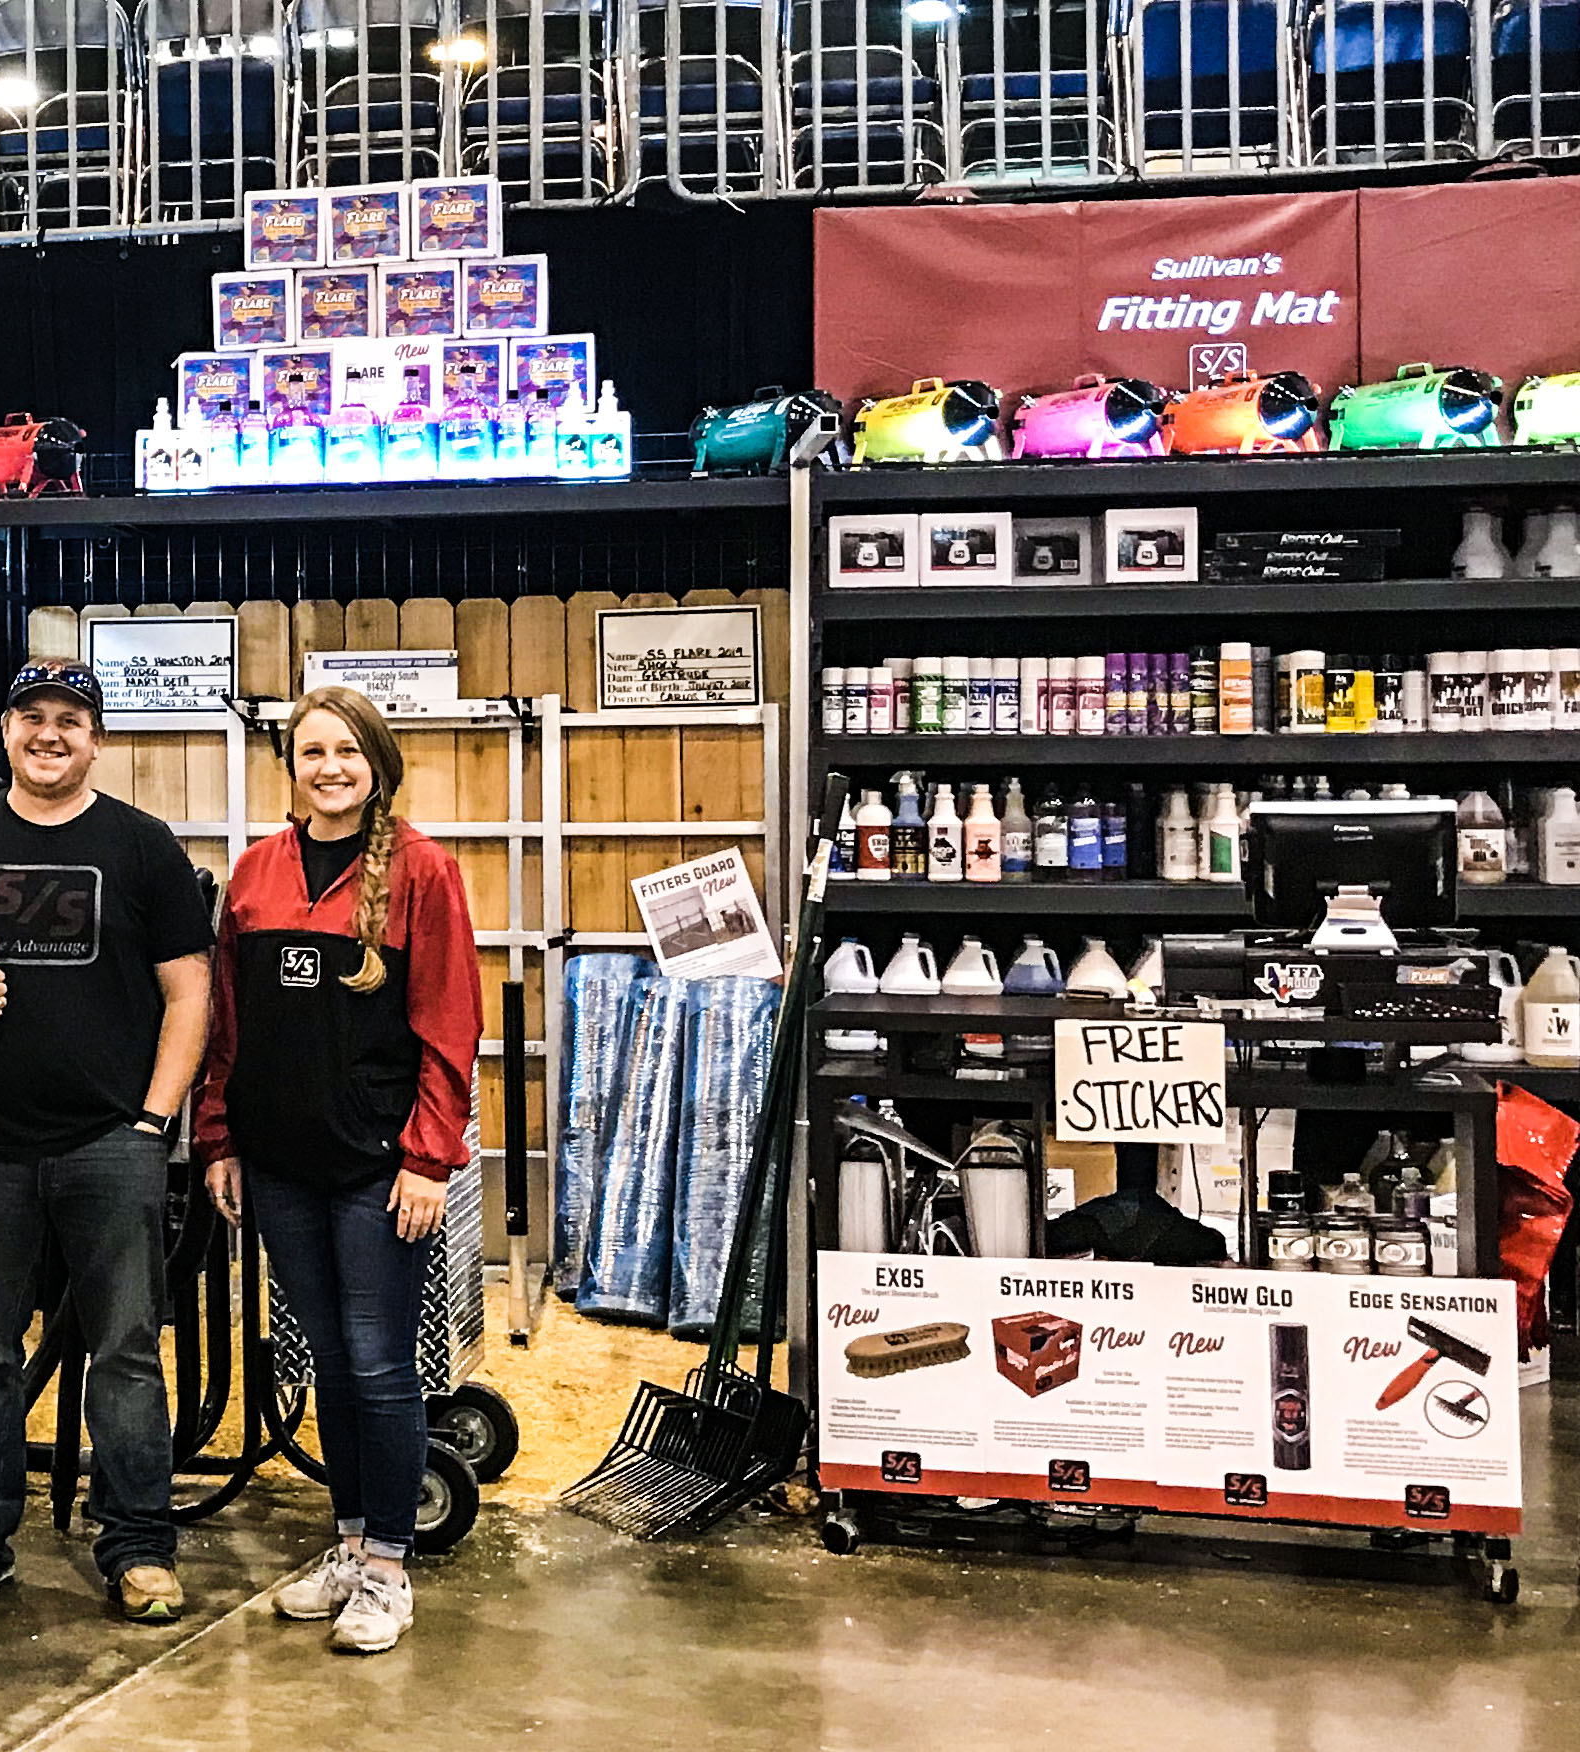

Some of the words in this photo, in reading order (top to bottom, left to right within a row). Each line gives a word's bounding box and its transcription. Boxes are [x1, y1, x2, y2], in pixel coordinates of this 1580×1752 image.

[347, 210, 385, 223] FLARE
[434, 202, 472, 215] FLARE
[265, 215, 304, 227] FLARE
[1151, 252, 1283, 281] Sullivan's
[316, 291, 354, 303] FLARE
[400, 288, 439, 301] FLARE
[482, 280, 521, 294] FLARE
[233, 298, 271, 310] FLARE
[1097, 293, 1243, 335] Fitting
[1250, 290, 1341, 326] Mat
[395, 344, 429, 360] New
[1196, 347, 1241, 379] S/S
[197, 374, 235, 387] FLARE
[674, 648, 712, 658] FLARE
[123, 667, 159, 677] RODEO
[103, 690, 120, 698] ate
[121, 688, 132, 698] of
[607, 683, 632, 693] Date
[636, 683, 647, 692] of
[105, 700, 139, 708] wners:
[640, 872, 691, 898] FITTERS
[693, 857, 736, 880] GUARD
[702, 874, 737, 896] New
[11, 939, 90, 955] Advantage
[285, 950, 315, 976] S/S
[1081, 1025, 1184, 1065] FREE
[1065, 1080, 1223, 1132] STICKERS
[876, 1266, 924, 1288] EX85
[1000, 1276, 1084, 1299] STARTER
[1091, 1279, 1134, 1300] KITS
[1192, 1283, 1248, 1306] SHOW
[1256, 1286, 1293, 1307] GLO
[1349, 1290, 1394, 1310] EDGE
[1400, 1292, 1499, 1313] SENSATION
[827, 1303, 880, 1328] New
[1090, 1326, 1145, 1352] New
[1168, 1332, 1224, 1358] New
[1343, 1336, 1402, 1363] New
